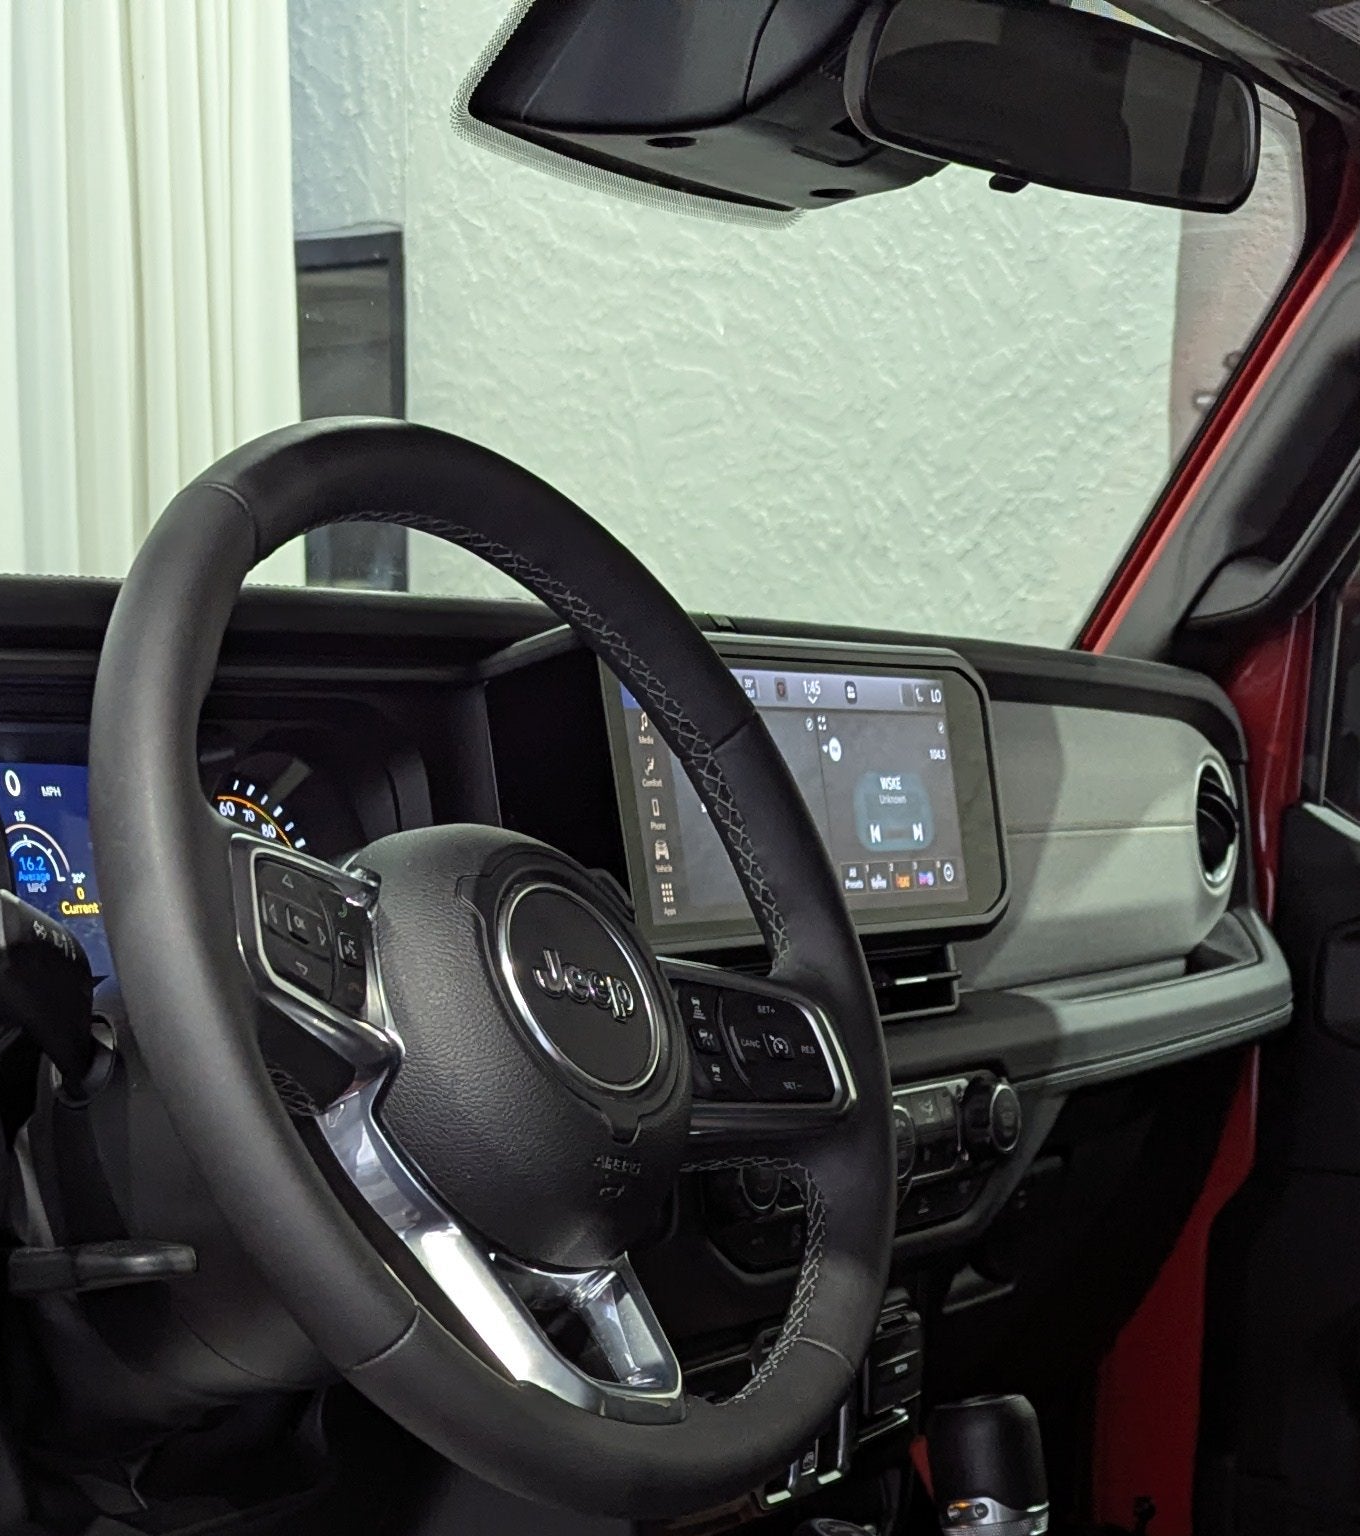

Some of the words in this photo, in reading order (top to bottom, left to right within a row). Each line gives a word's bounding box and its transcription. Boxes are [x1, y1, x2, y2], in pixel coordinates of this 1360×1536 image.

[803, 680, 821, 695] 1:45
[930, 689, 942, 703] LO
[5, 770, 21, 797] 0
[41, 786, 62, 797] MPH
[219, 801, 236, 817] 60
[242, 809, 255, 823] 70
[261, 824, 277, 839] 80
[19, 856, 47, 871] 16.2
[18, 872, 51, 883] Average
[27, 883, 47, 893] MPG
[61, 901, 100, 915] Current
[532, 947, 635, 1024] Jeep
